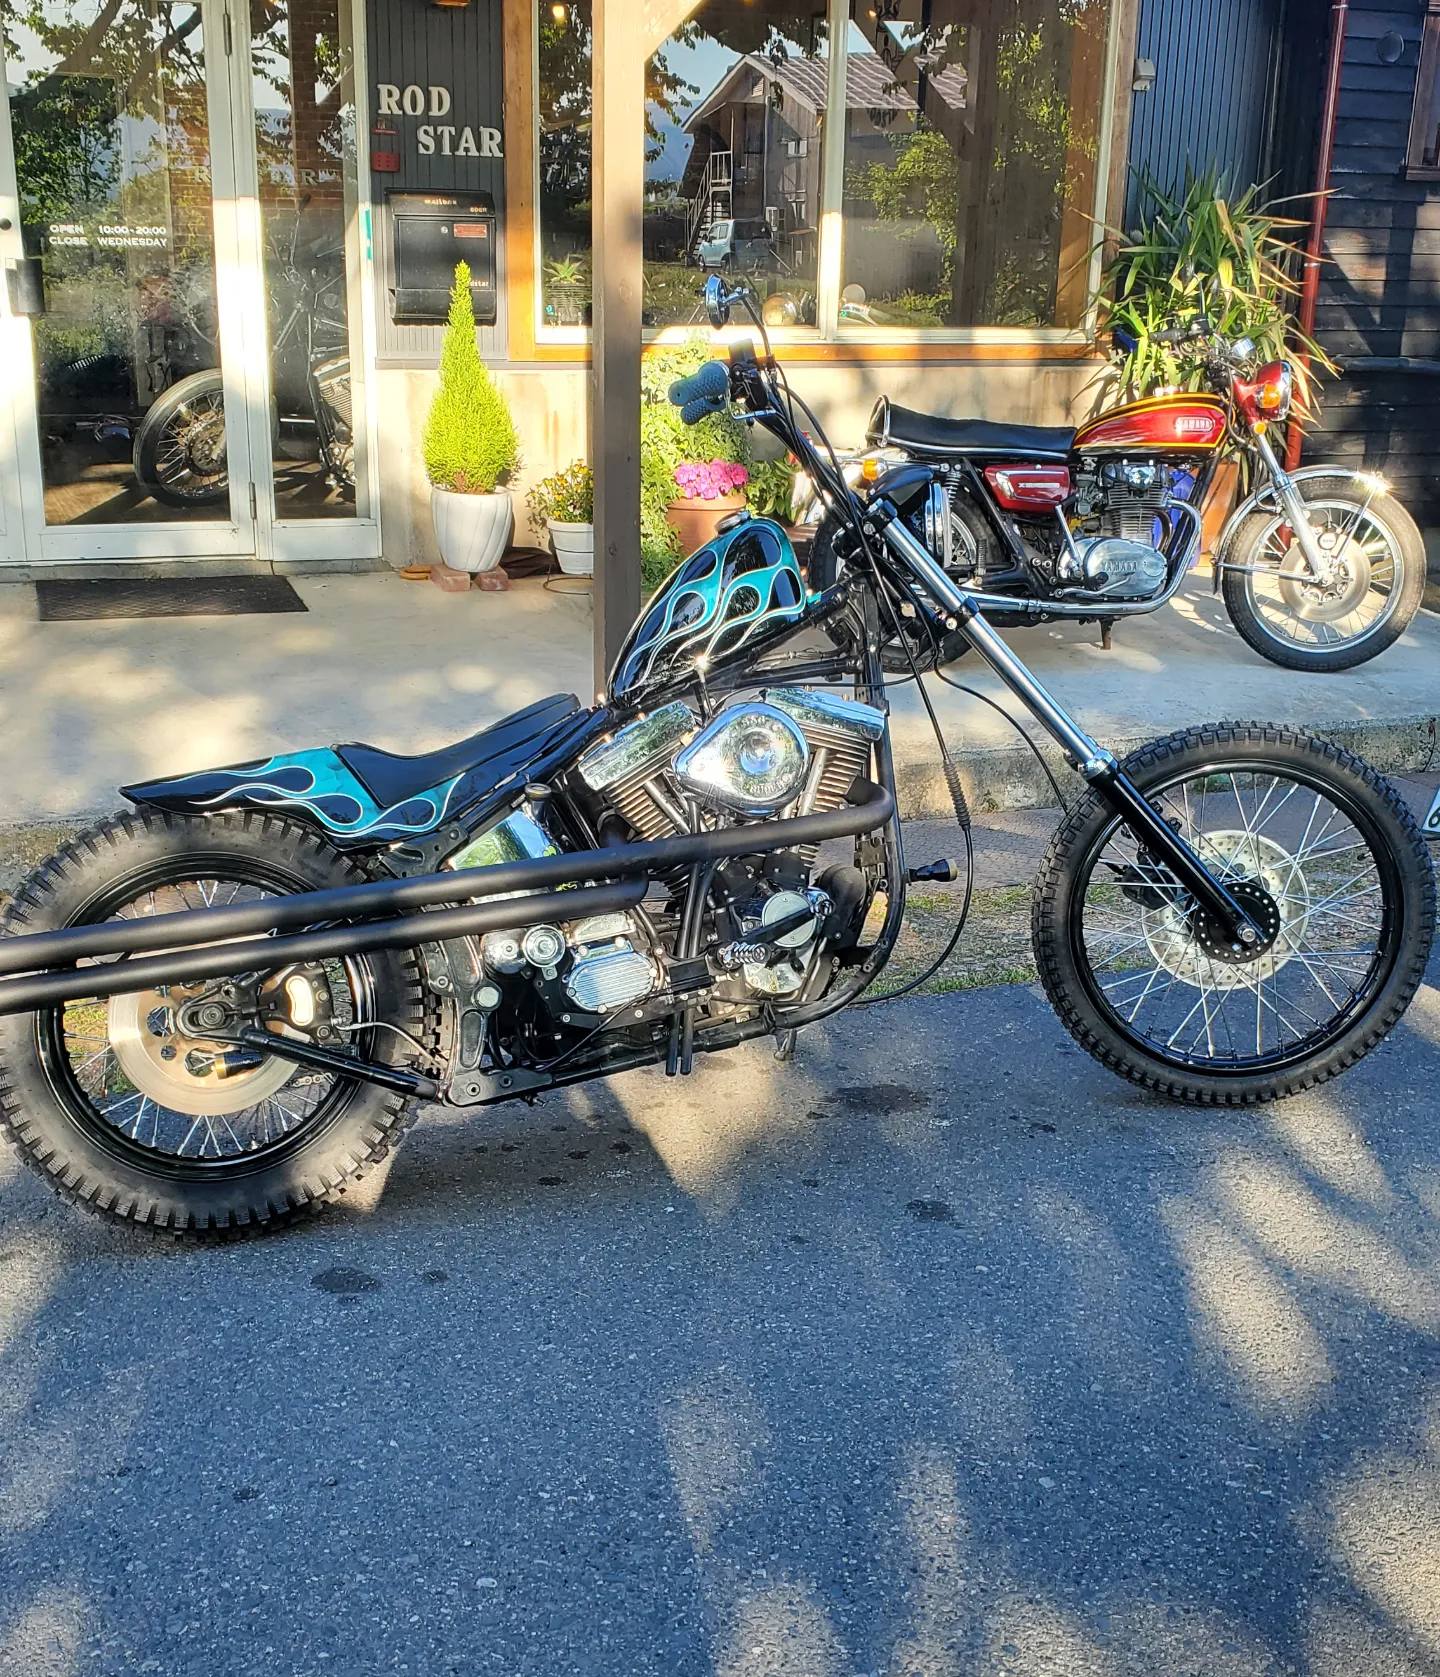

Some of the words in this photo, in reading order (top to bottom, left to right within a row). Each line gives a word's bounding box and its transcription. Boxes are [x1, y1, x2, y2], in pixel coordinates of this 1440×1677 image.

[377, 84, 451, 116] ROD
[416, 125, 504, 157] STAR
[49, 224, 85, 235] OPEN
[48, 236, 88, 246] CLOSE
[97, 237, 167, 248] WEDNESDAY
